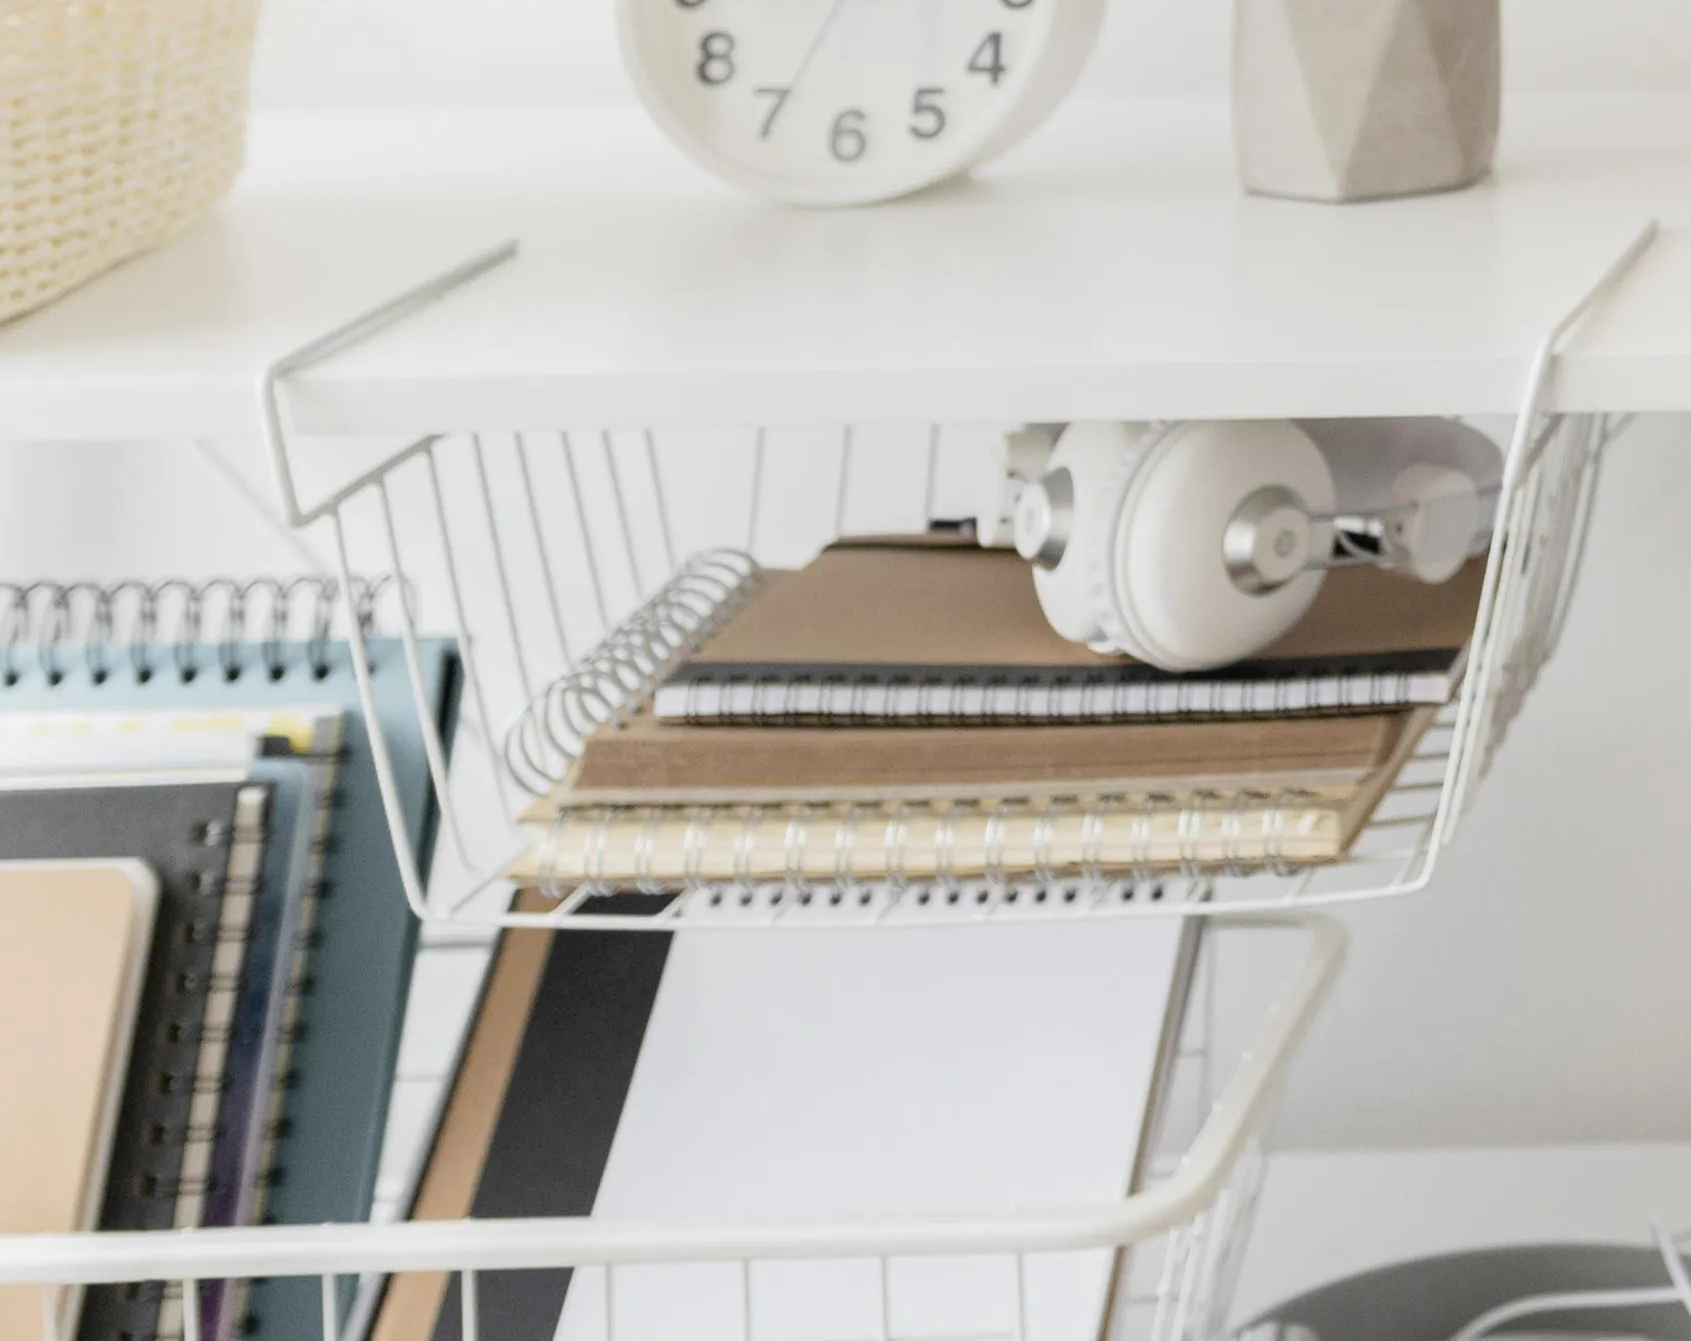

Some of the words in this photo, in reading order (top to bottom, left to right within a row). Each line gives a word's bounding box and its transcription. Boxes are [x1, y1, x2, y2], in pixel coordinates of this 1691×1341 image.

[695, 31, 736, 86] 8
[966, 31, 1008, 86] 4
[753, 87, 793, 140] 7
[829, 108, 868, 163] 6
[908, 87, 947, 140] 5
